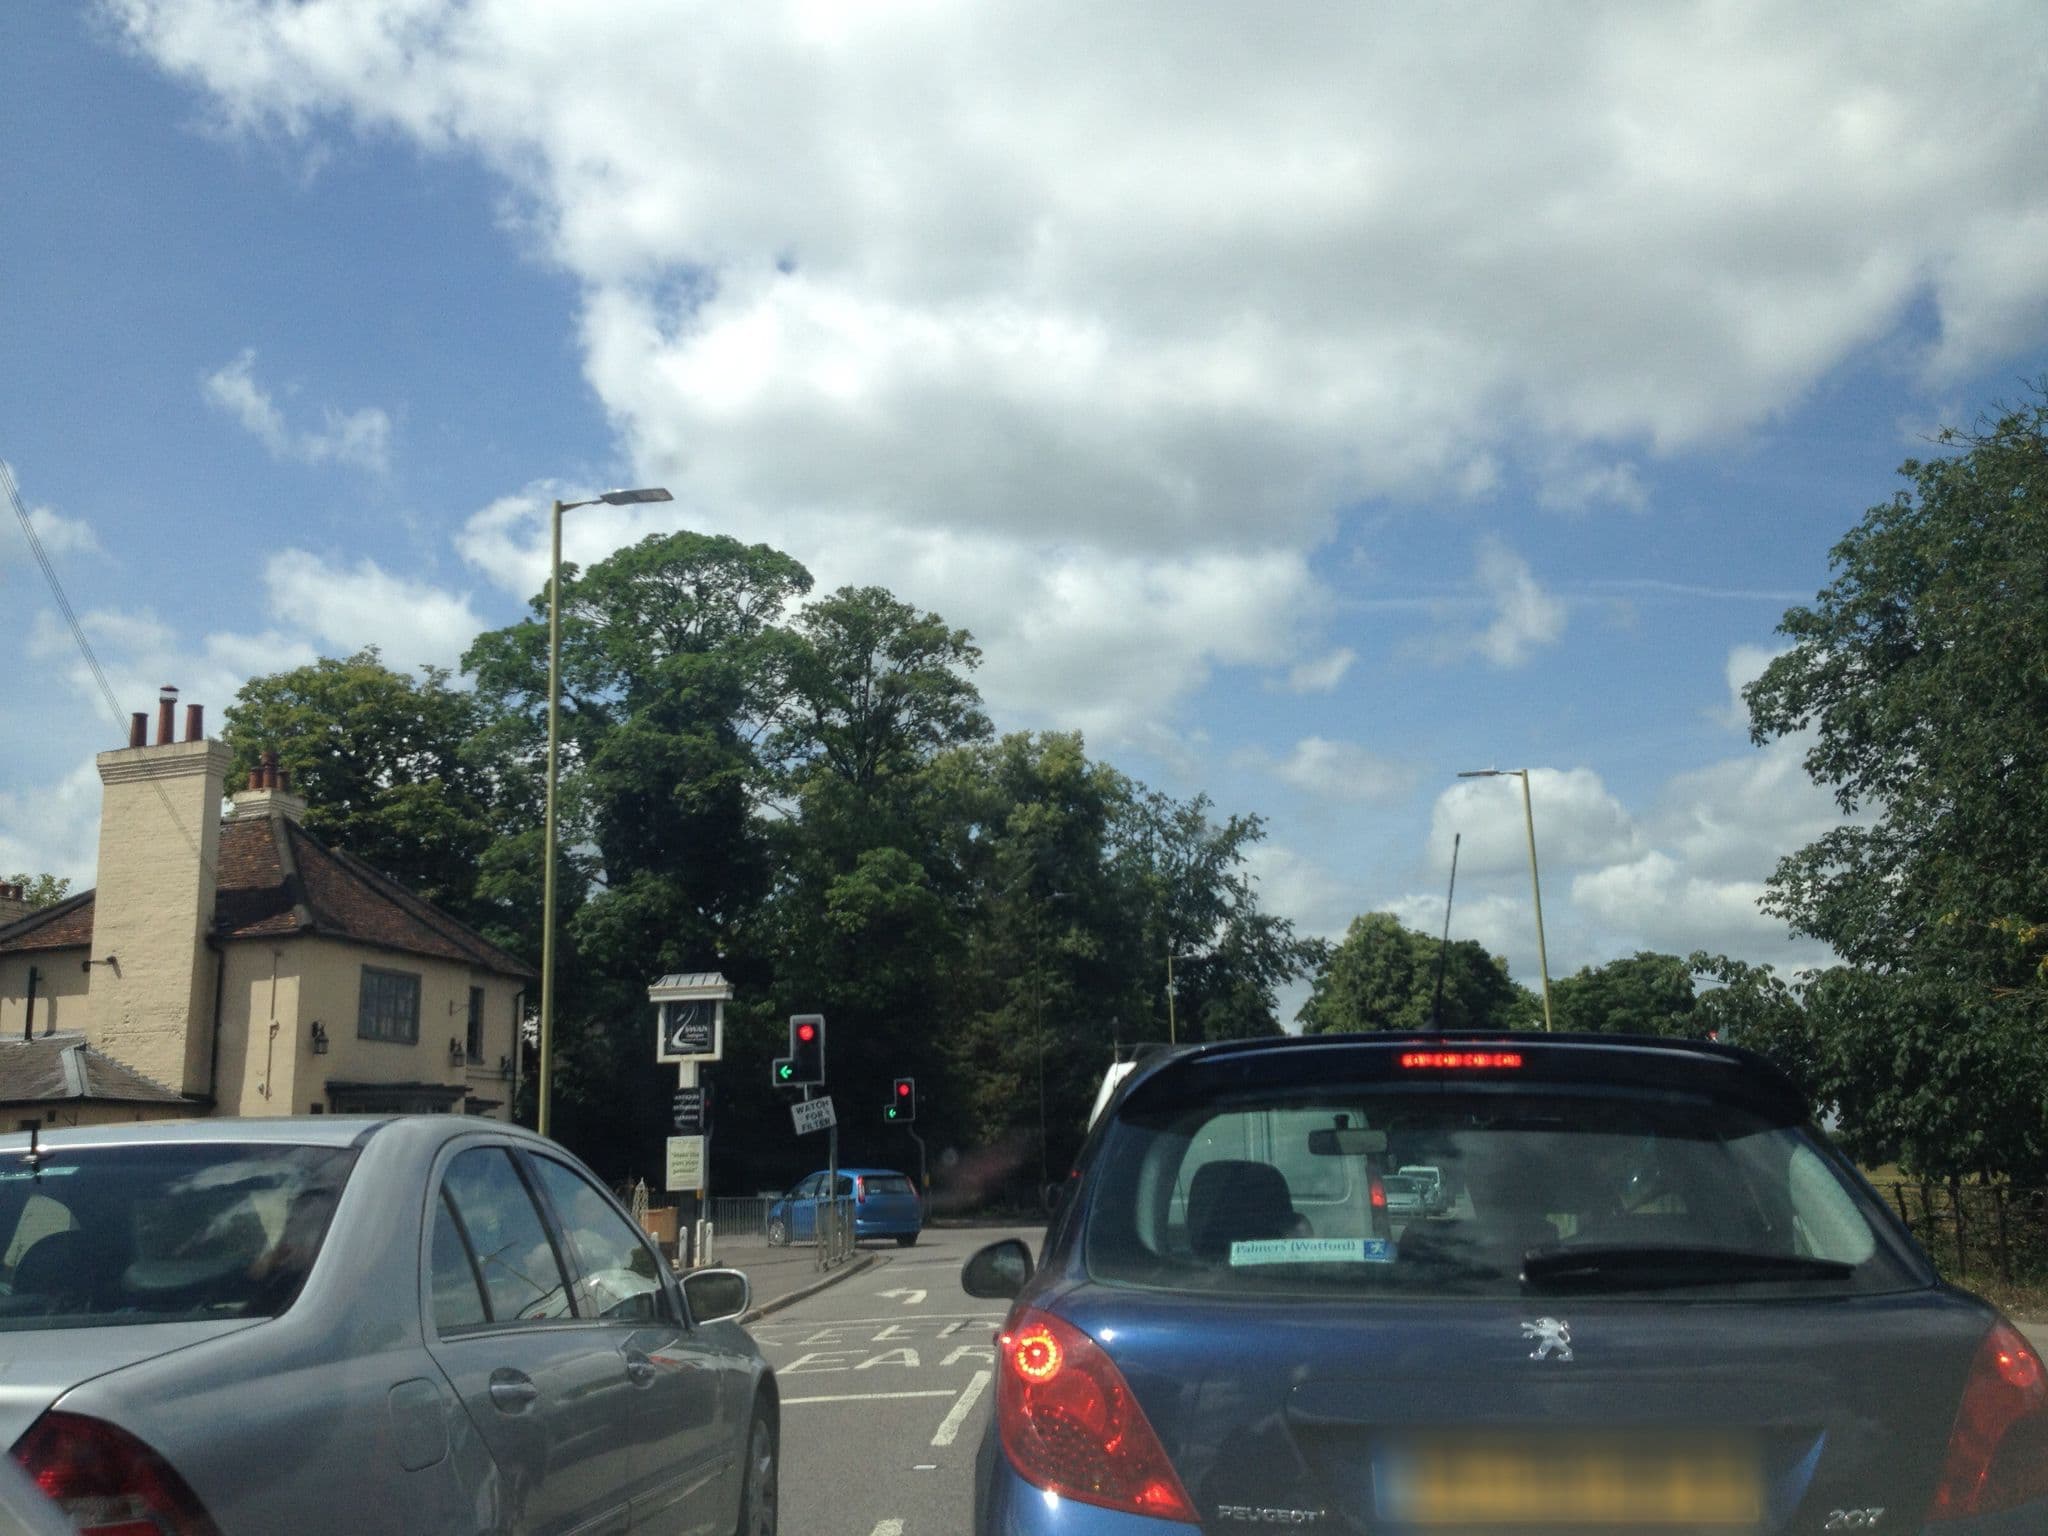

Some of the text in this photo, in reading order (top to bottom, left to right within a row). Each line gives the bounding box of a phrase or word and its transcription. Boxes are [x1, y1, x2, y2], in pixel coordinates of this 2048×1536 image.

[795, 1100, 830, 1114] WATCH
[805, 1110, 823, 1120] FOR
[802, 1117, 830, 1131] FILTER
[1218, 1504, 1318, 1521] PEUGEOT
[1824, 1508, 1885, 1529] 207
